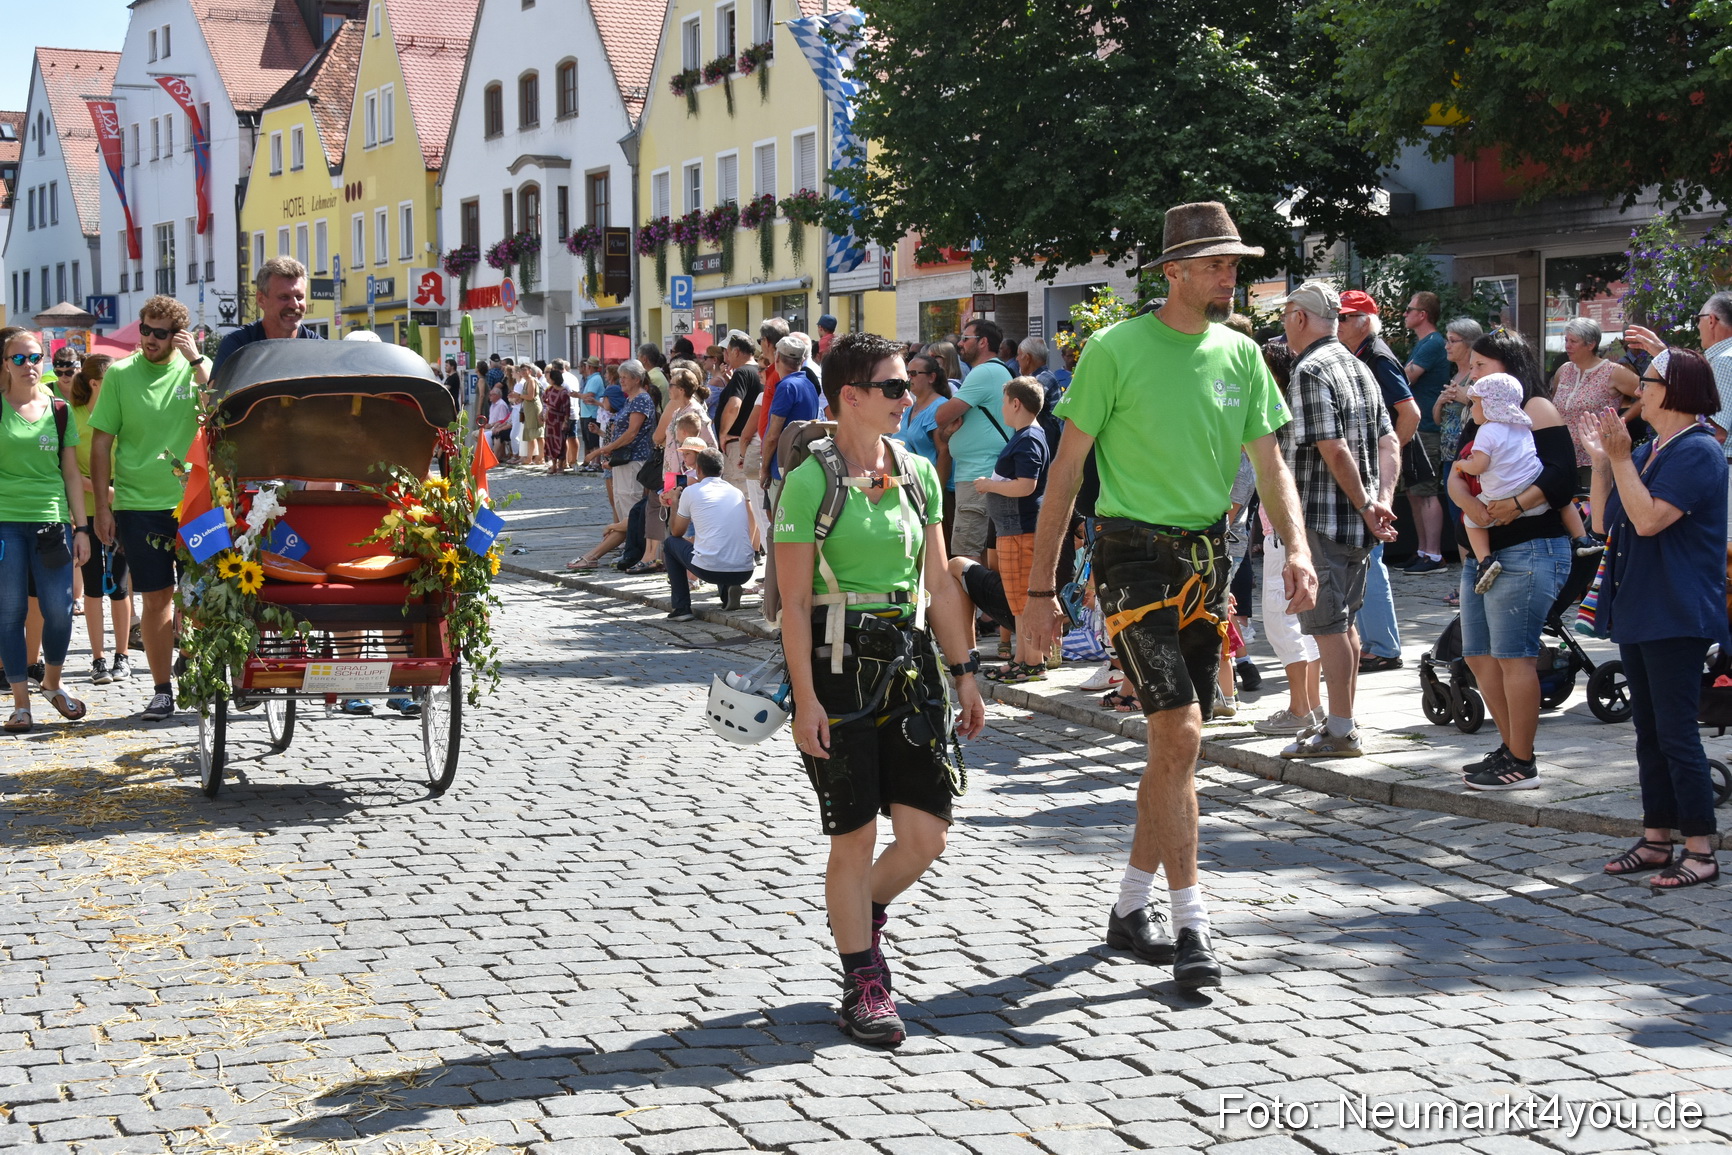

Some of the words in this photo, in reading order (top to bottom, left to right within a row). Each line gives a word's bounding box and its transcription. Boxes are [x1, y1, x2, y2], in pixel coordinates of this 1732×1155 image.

[283, 196, 305, 218] HOTEL
[312, 195, 337, 211] Lehmeier
[675, 280, 688, 305] P
